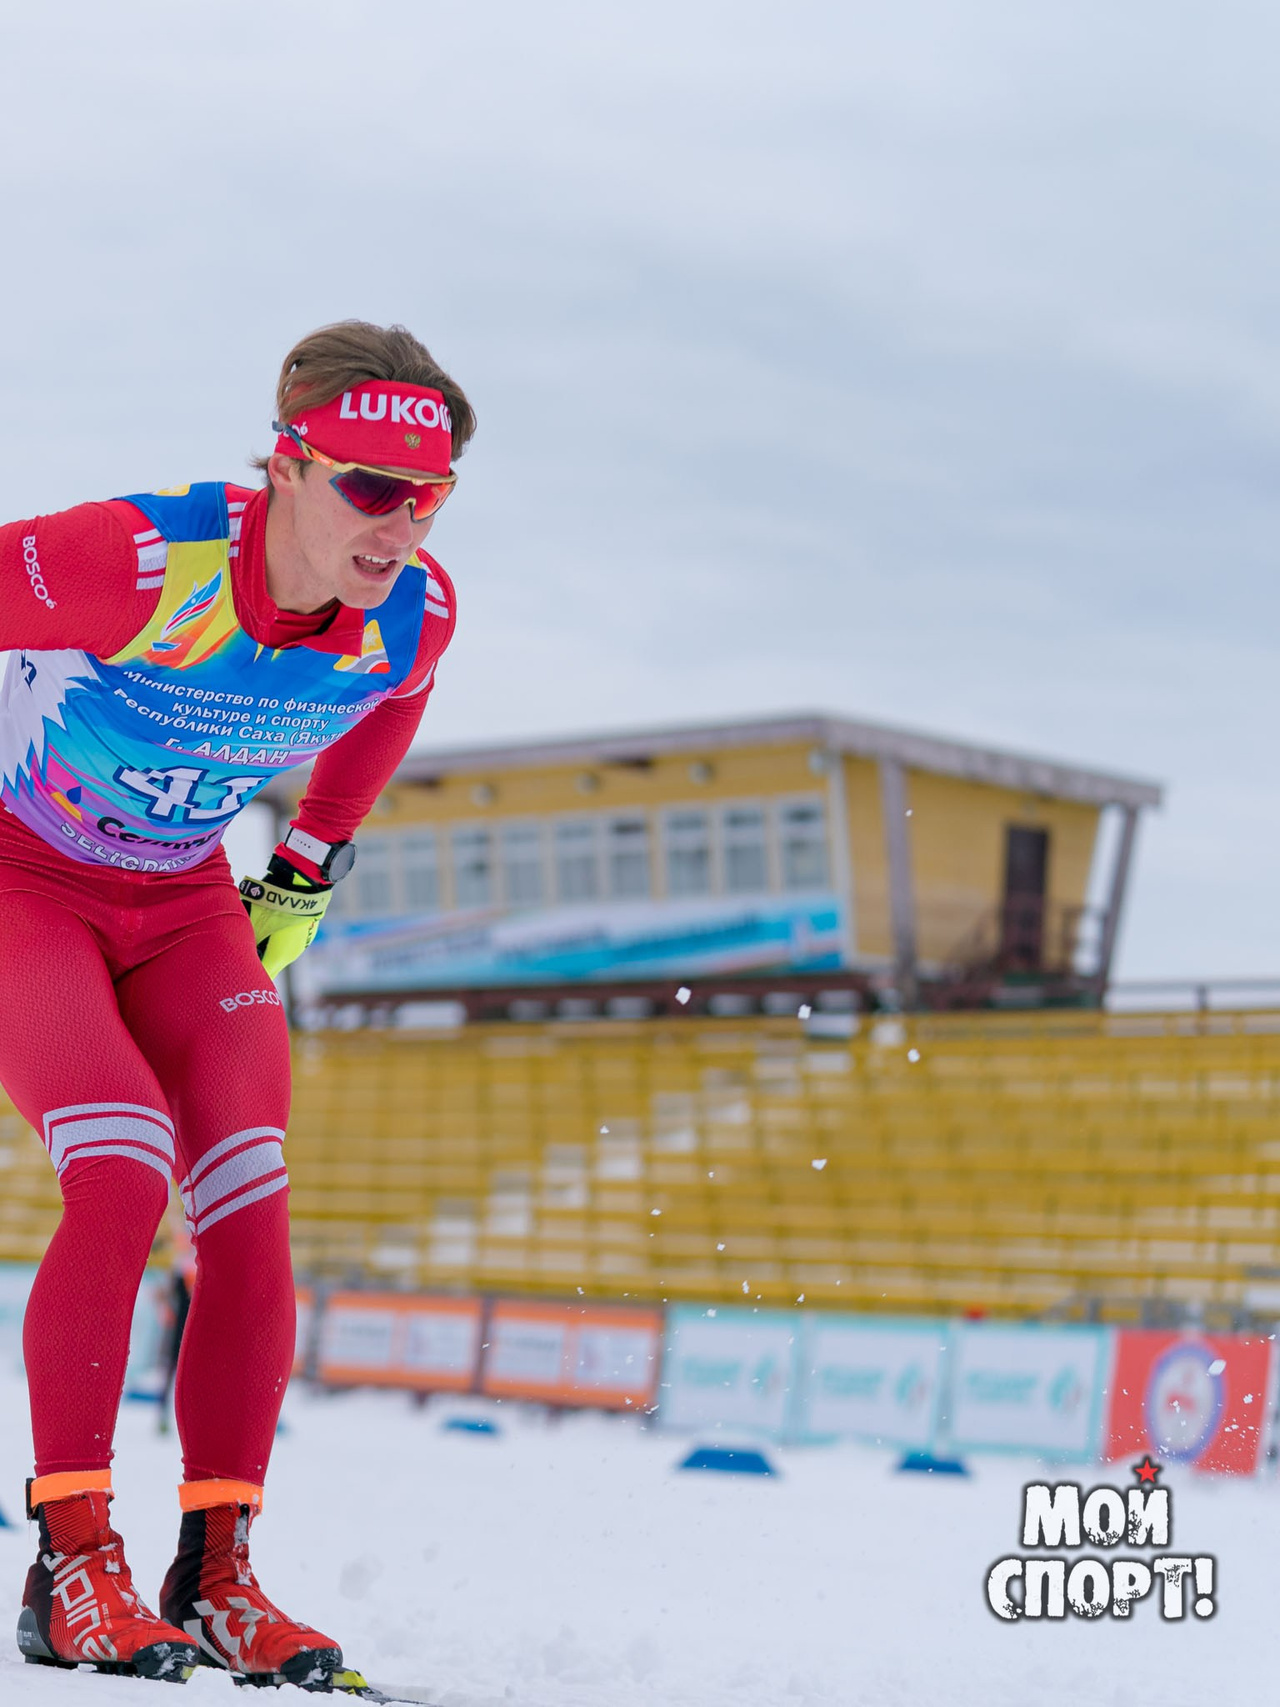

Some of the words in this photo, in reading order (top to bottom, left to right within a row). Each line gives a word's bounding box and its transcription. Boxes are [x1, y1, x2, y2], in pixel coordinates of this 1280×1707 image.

[22, 535, 48, 601] BOSCO
[113, 687, 234, 738] Республики
[238, 725, 285, 743] Саха
[171, 702, 251, 724] культуре
[255, 713, 267, 725] и
[271, 714, 329, 732] спорту
[257, 696, 279, 710] по
[283, 697, 380, 716] физической
[192, 740, 290, 766] АЛДАН
[219, 989, 280, 1013] BOSCO
